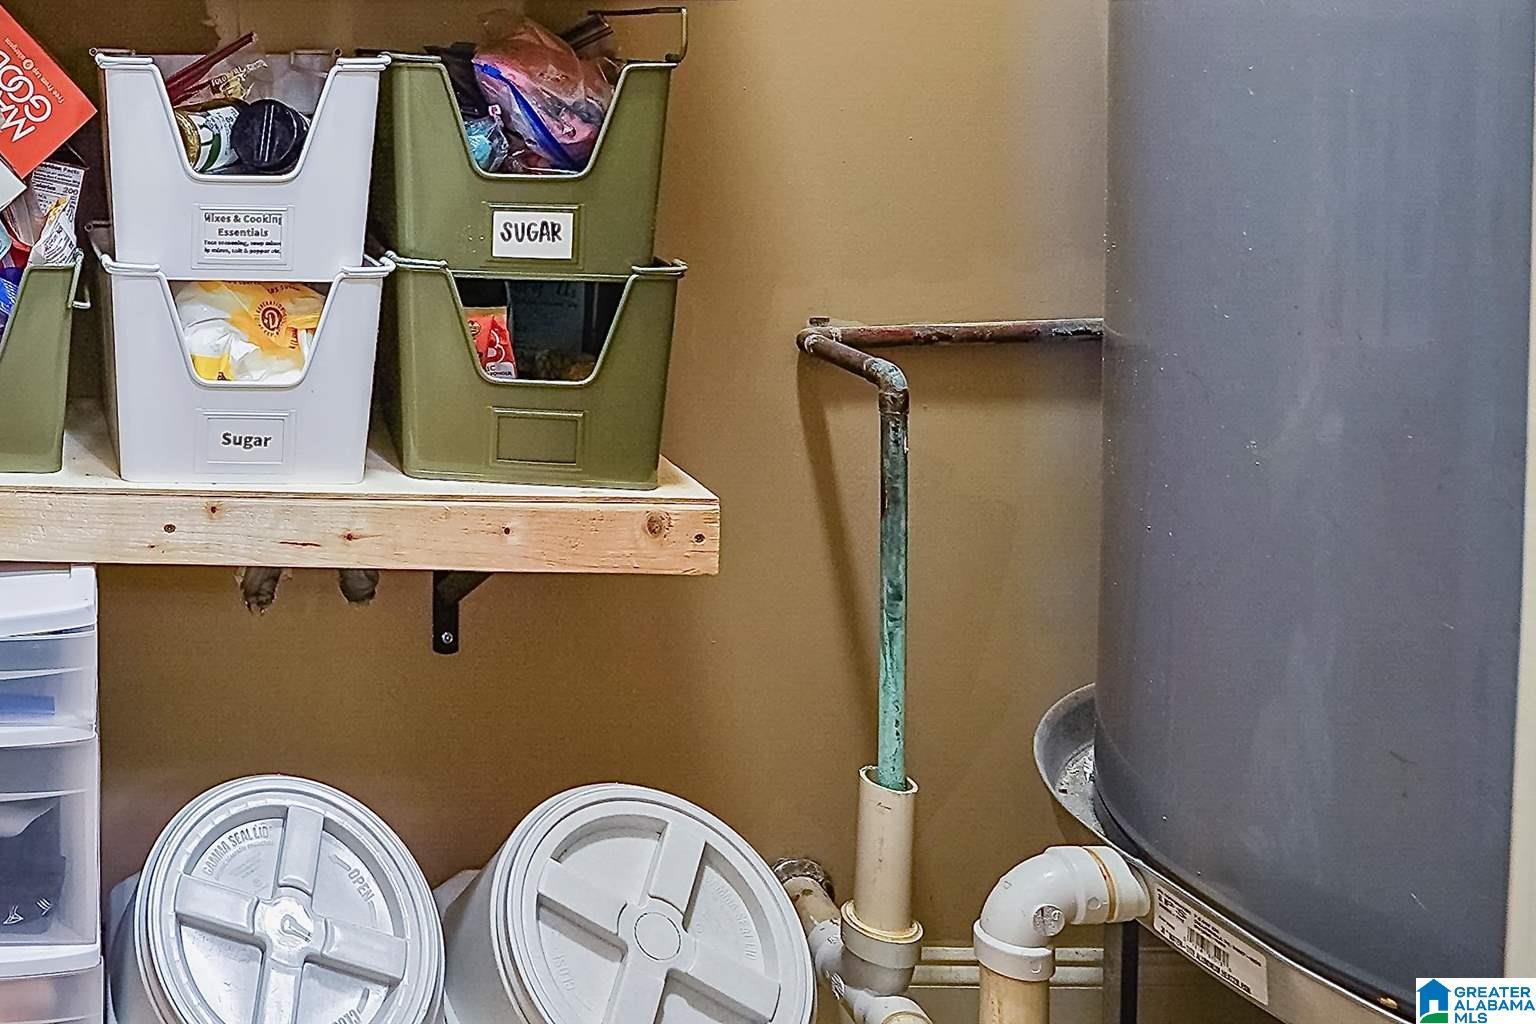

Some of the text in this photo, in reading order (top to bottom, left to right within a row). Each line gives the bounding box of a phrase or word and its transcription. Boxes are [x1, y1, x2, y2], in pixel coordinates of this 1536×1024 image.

[233, 215, 241, 223] &
[218, 228, 269, 237] Essentials
[500, 221, 562, 242] SUGAR
[221, 432, 272, 450] Sugar
[203, 824, 270, 876] GAMMA SEAL LID
[348, 867, 375, 902] OPEN
